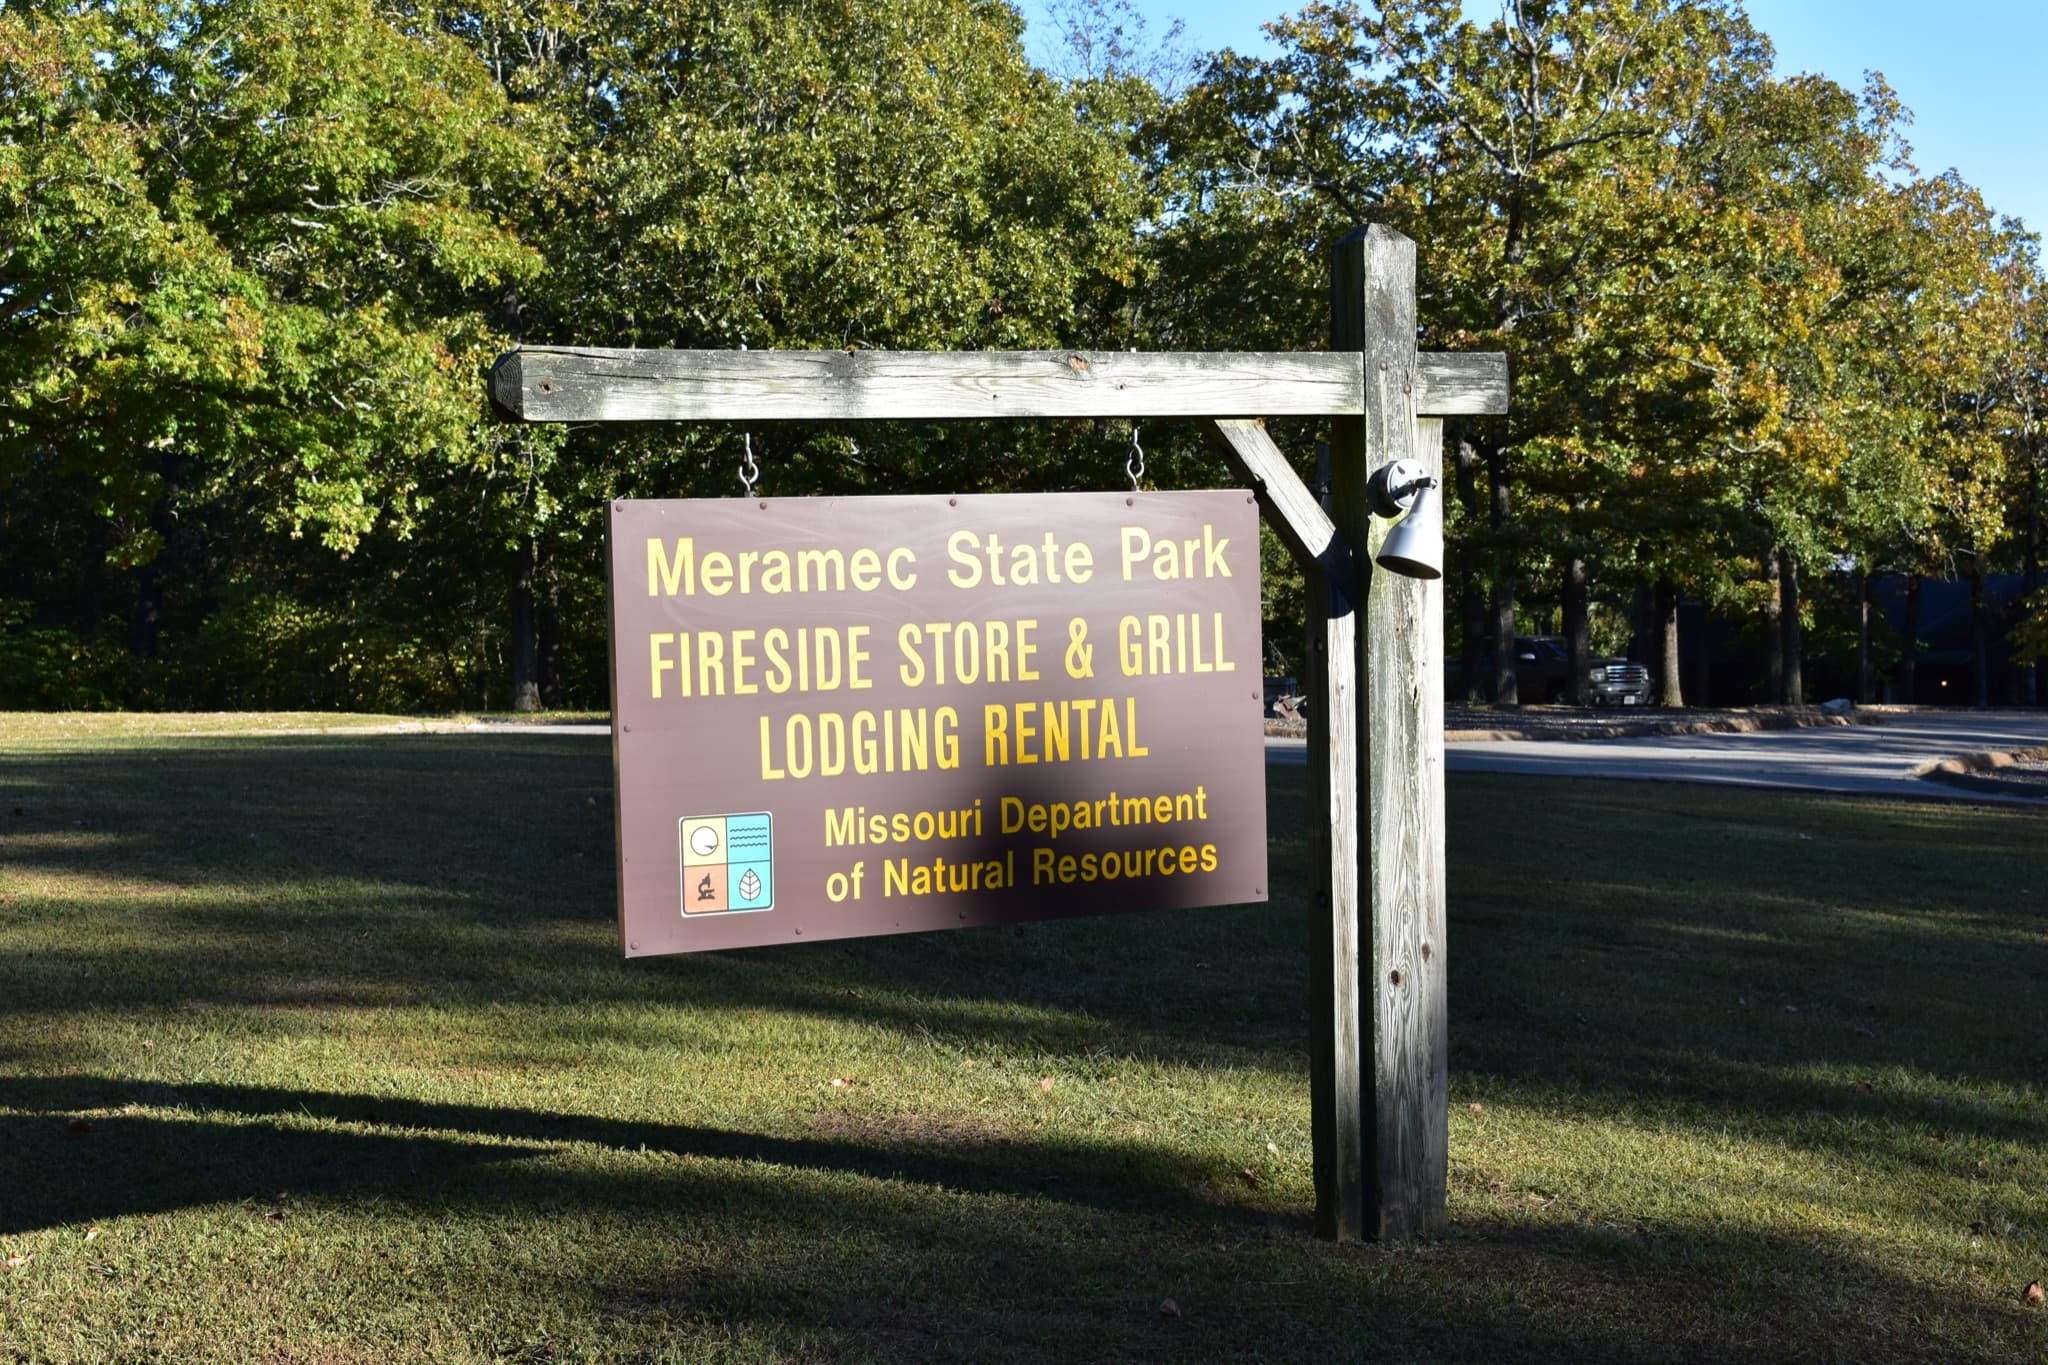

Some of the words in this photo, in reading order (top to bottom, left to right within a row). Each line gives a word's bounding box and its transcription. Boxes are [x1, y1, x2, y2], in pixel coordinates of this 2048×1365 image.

[647, 537, 917, 597] Meramec
[947, 530, 1093, 588] State
[1121, 524, 1233, 581] Park
[649, 626, 874, 699] FIRESIDE
[898, 620, 1040, 688] STORE
[1064, 616, 1095, 680] &
[1119, 612, 1236, 677] GRILL
[759, 706, 960, 780] LODGING
[984, 697, 1149, 767] RENTAL
[825, 799, 982, 848] Missouri
[1001, 785, 1208, 839] Department
[825, 861, 864, 903] of
[883, 851, 1014, 898] Natural
[1033, 843, 1219, 886] Resources
